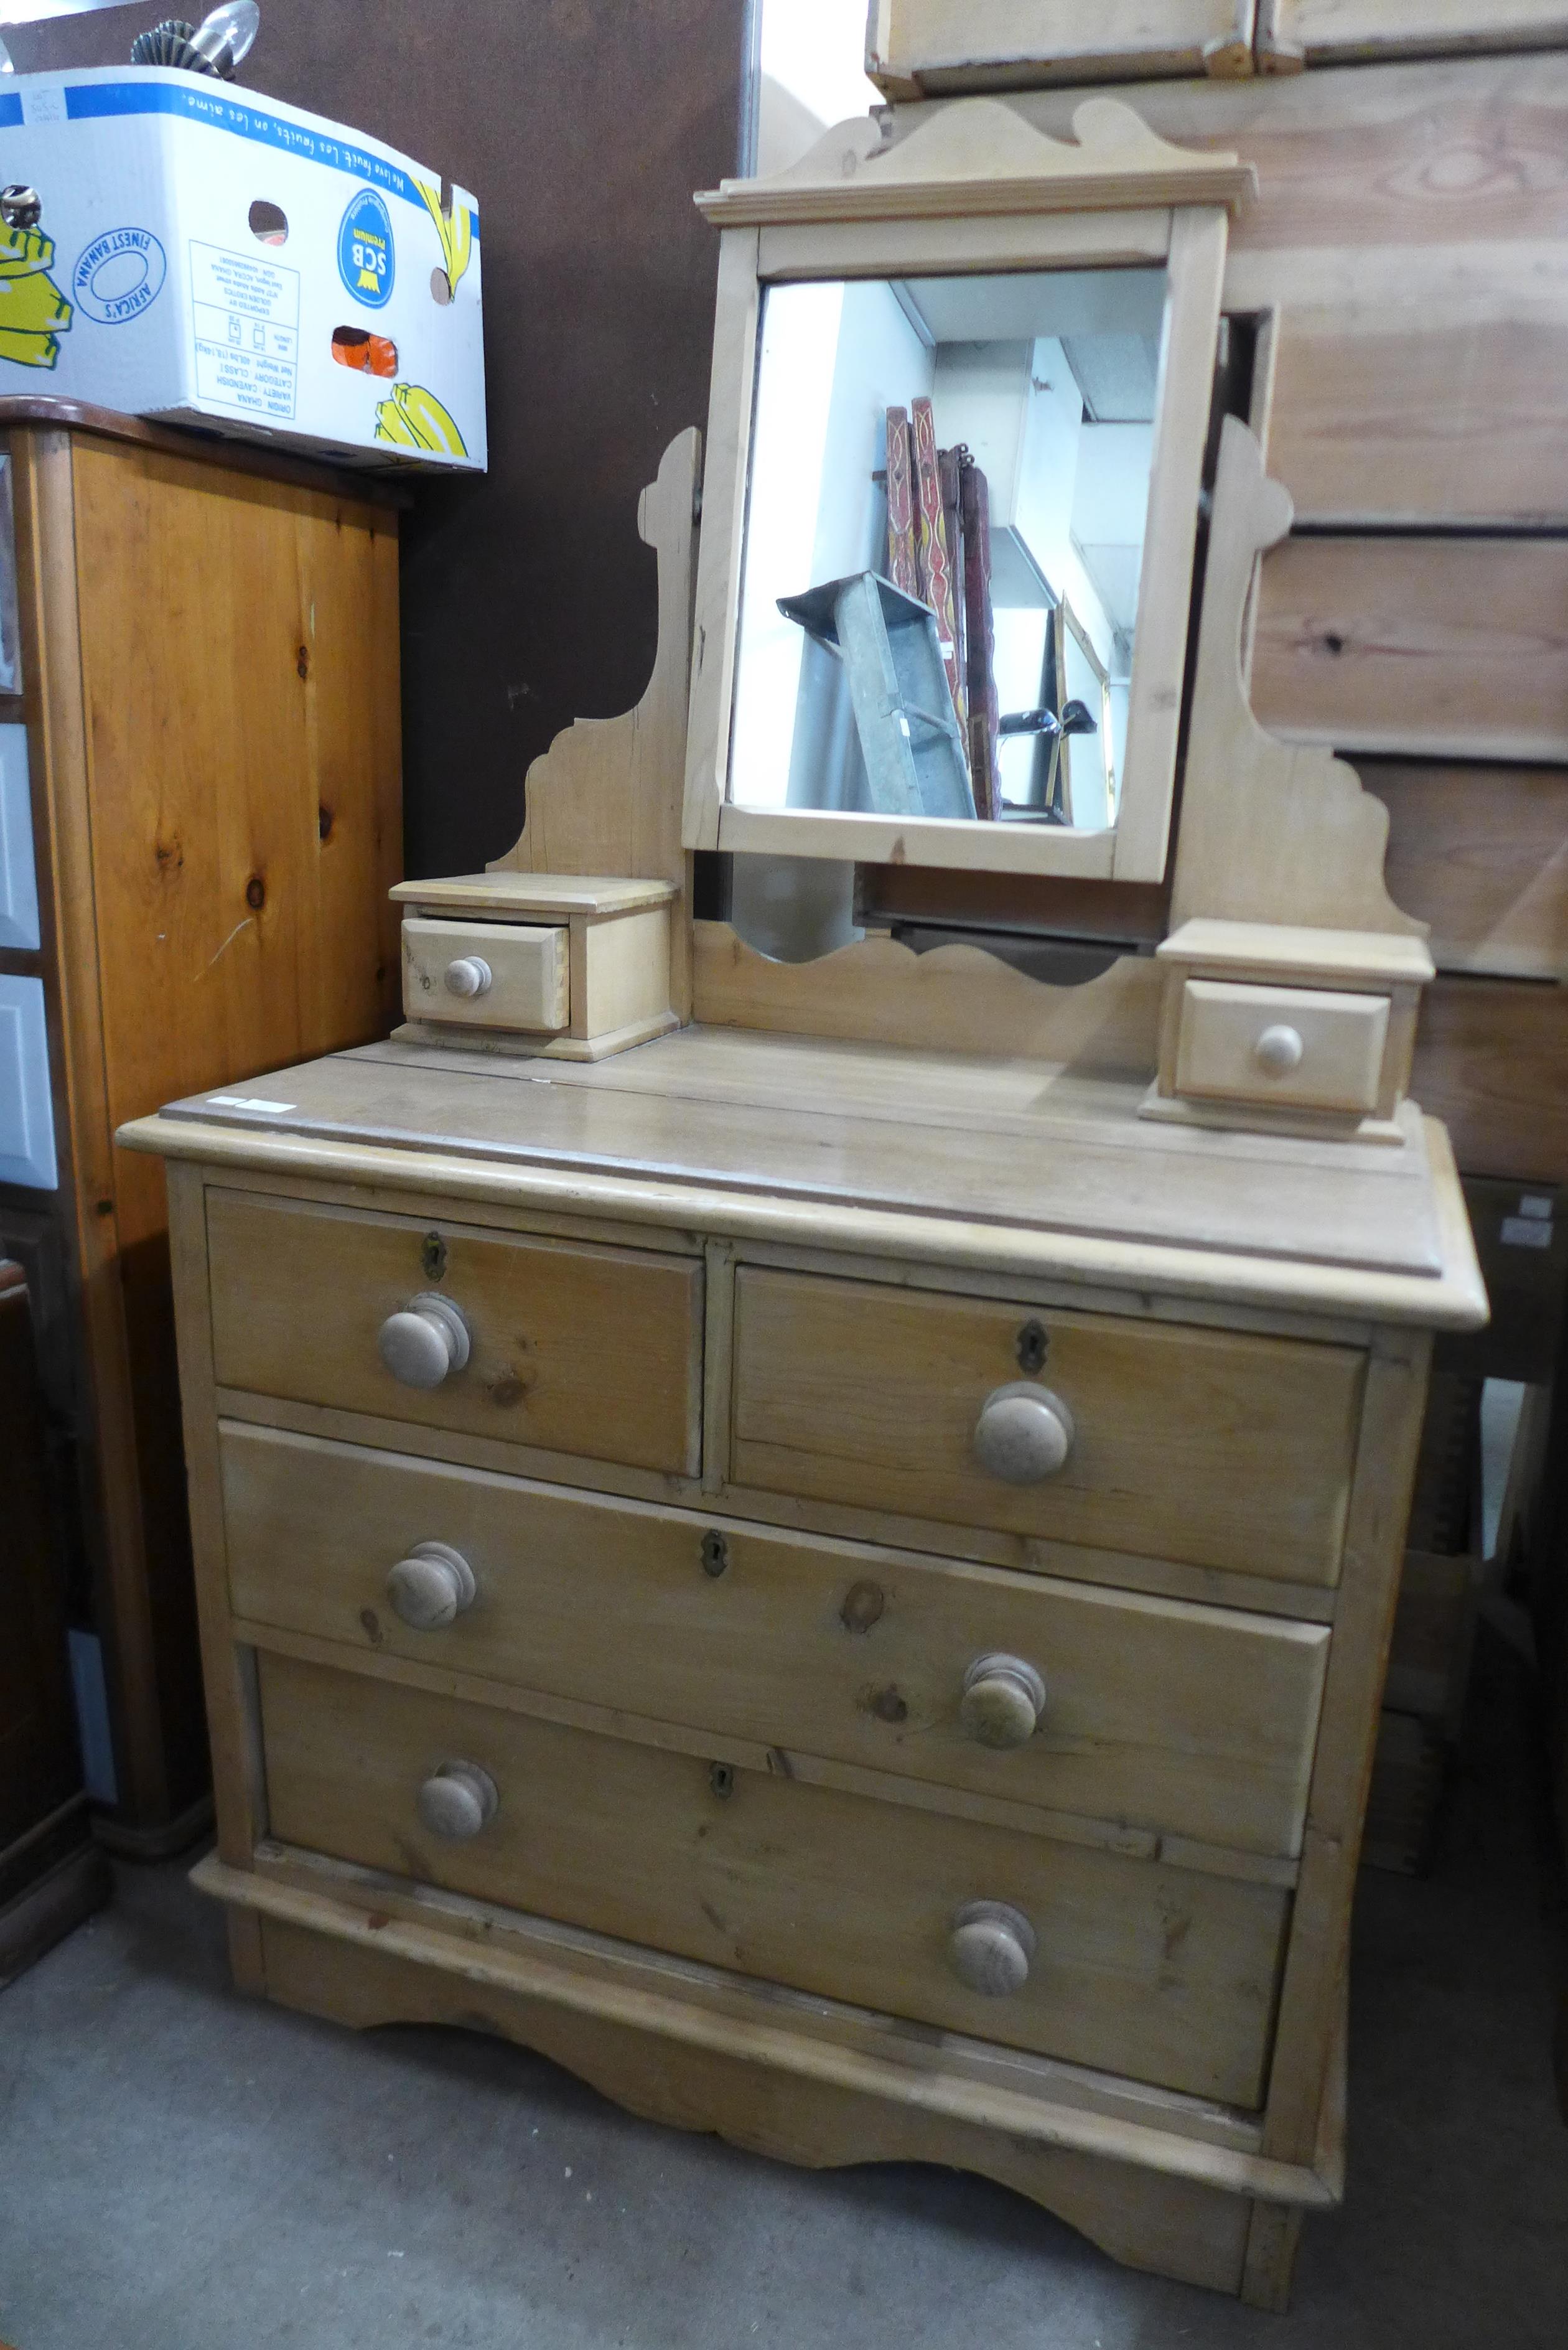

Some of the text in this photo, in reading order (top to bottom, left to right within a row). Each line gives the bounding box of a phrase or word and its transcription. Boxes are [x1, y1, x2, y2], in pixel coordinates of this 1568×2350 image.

[229, 110, 249, 131] les
[254, 119, 268, 131] on
[320, 142, 338, 164] Les
[375, 164, 391, 185] love
[353, 228, 386, 251] Premium
[77, 232, 151, 287] FINEST BANANA
[352, 243, 386, 276] SCB
[105, 283, 151, 318] AFRICA'S
[229, 299, 269, 316] EXPORTED BY
[249, 294, 271, 307] GOLDEN
[225, 364, 249, 378] CLASS
[256, 360, 279, 373] Weight
[281, 367, 292, 377] Net
[217, 375, 291, 401] VARIETY CAVENDISH
[254, 373, 292, 389] CATEGORY
[237, 393, 291, 414] ORIGIN GHANA
